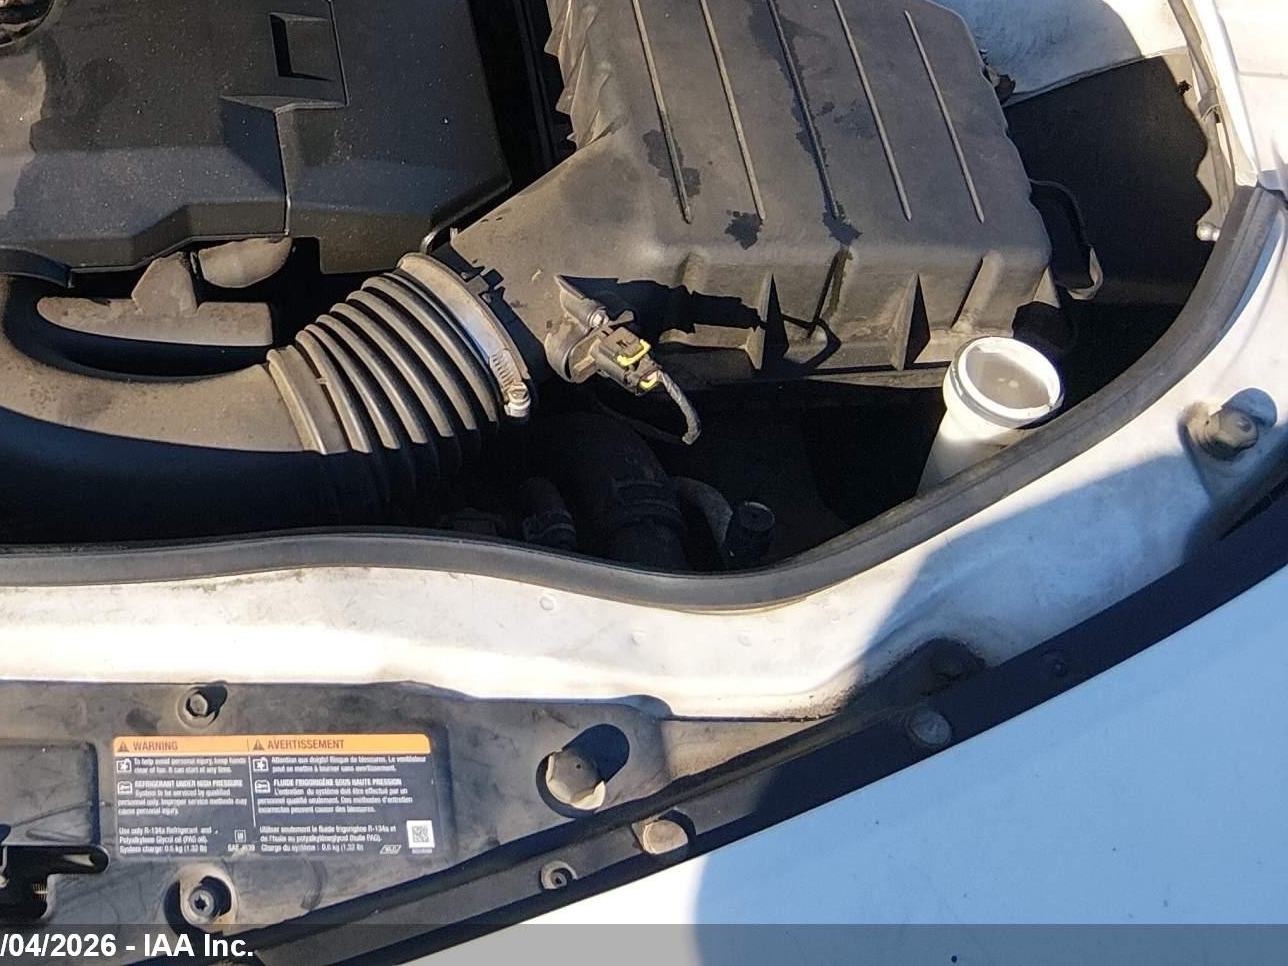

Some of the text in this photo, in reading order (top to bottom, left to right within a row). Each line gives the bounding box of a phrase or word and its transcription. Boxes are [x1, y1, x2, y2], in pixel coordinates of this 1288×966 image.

[133, 741, 178, 751] WARNING
[267, 739, 345, 750] AVERTISSEMENT
[134, 780, 174, 788] REFRIGERANT
[175, 780, 196, 788] UNDER
[212, 780, 243, 788] PRESSURE
[274, 778, 294, 787] FLUIDE
[335, 778, 351, 787] SOUS
[352, 778, 371, 787] HAUTE
[372, 778, 402, 787] PRESSION
